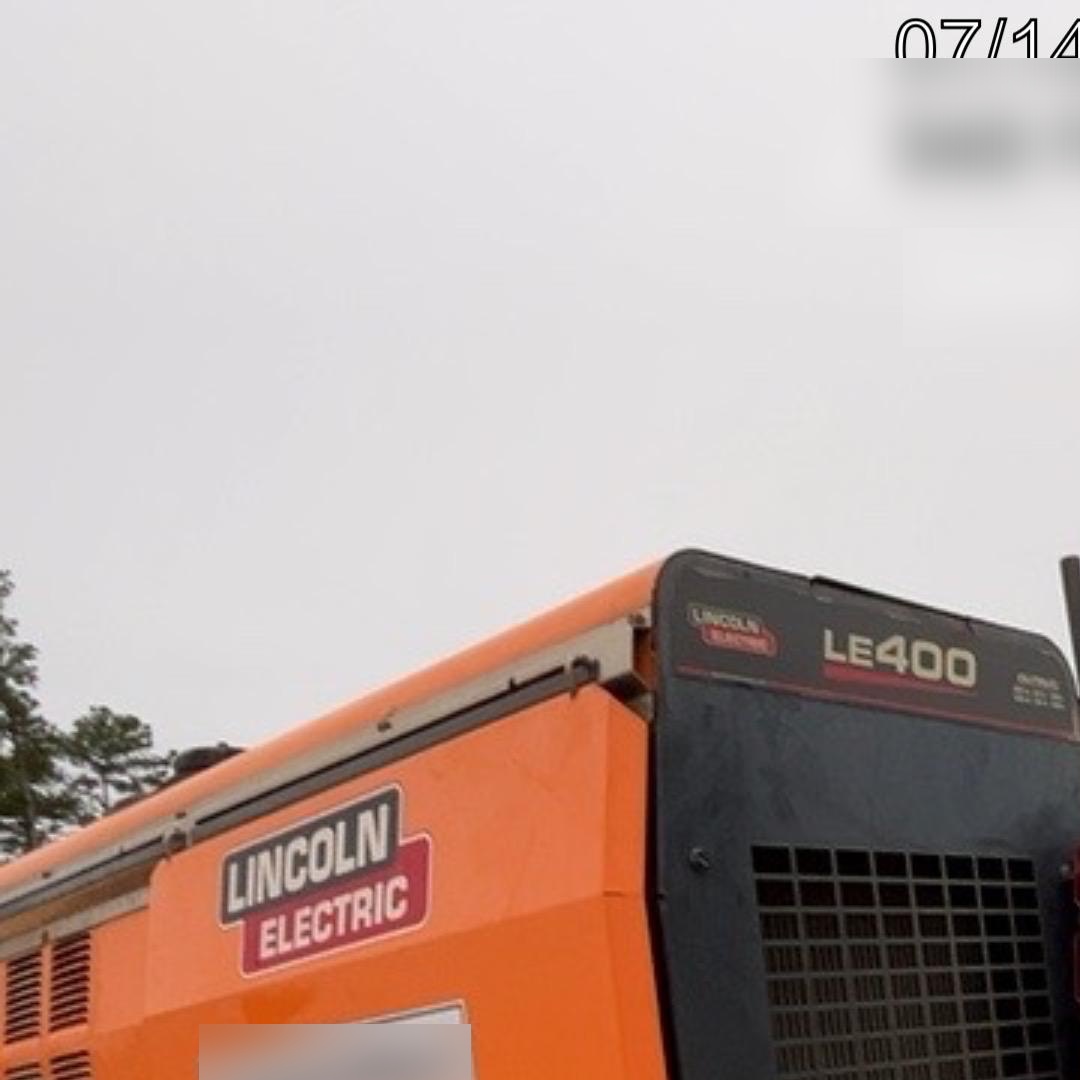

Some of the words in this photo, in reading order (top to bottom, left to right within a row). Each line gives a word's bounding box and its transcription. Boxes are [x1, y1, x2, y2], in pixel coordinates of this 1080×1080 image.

[823, 628, 977, 688] LE400
[226, 802, 389, 914] LINCOLN
[259, 874, 409, 961] ELECTRIC
